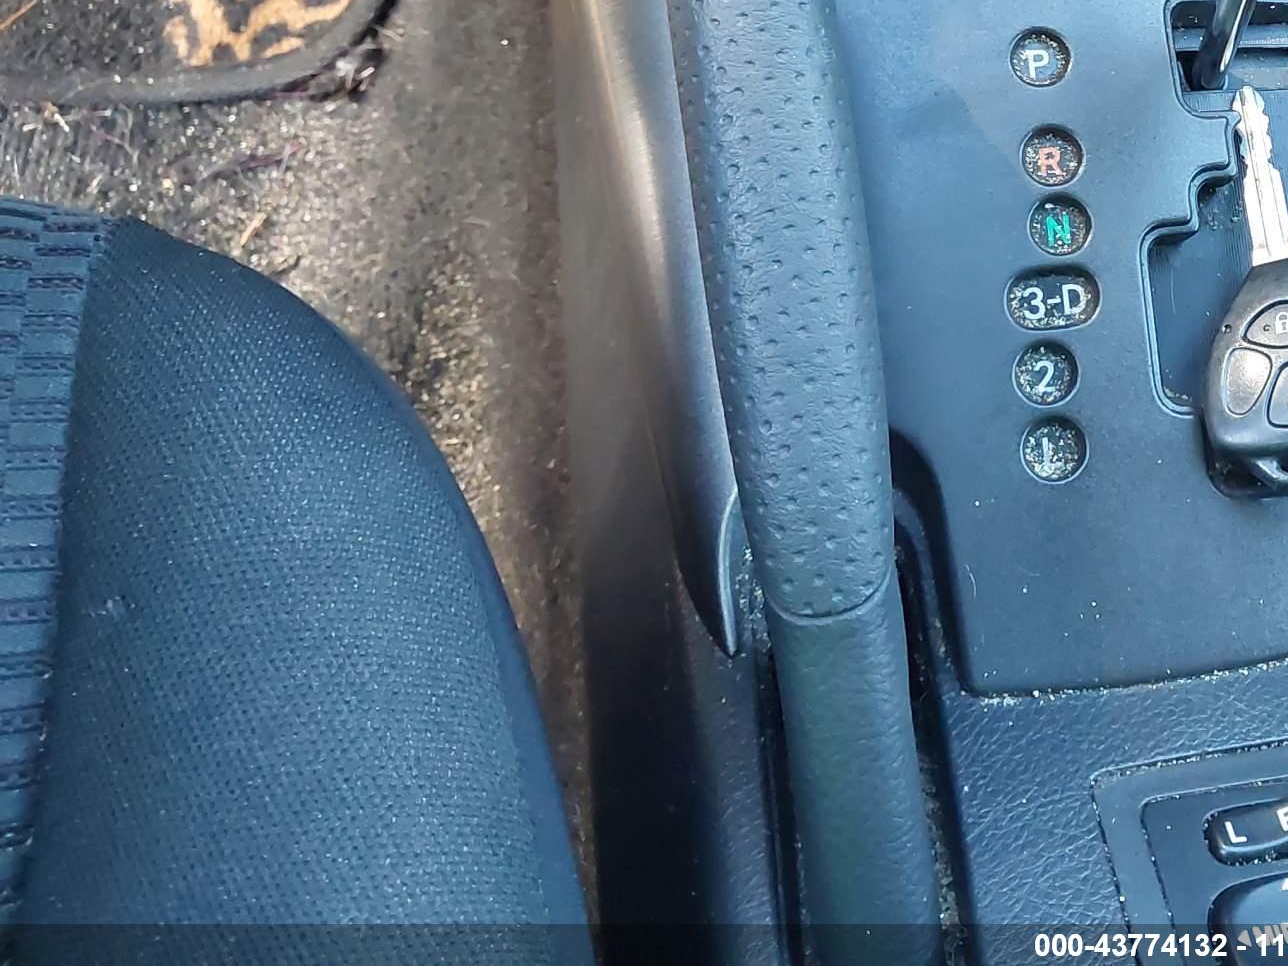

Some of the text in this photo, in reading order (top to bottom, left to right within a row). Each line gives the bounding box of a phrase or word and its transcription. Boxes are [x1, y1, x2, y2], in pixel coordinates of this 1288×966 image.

[1024, 49, 1049, 79] P
[1038, 144, 1063, 176] R
[1046, 213, 1071, 246] N
[1023, 284, 1085, 320] 3-D
[1034, 360, 1055, 393] 2
[1225, 821, 1247, 843] L
